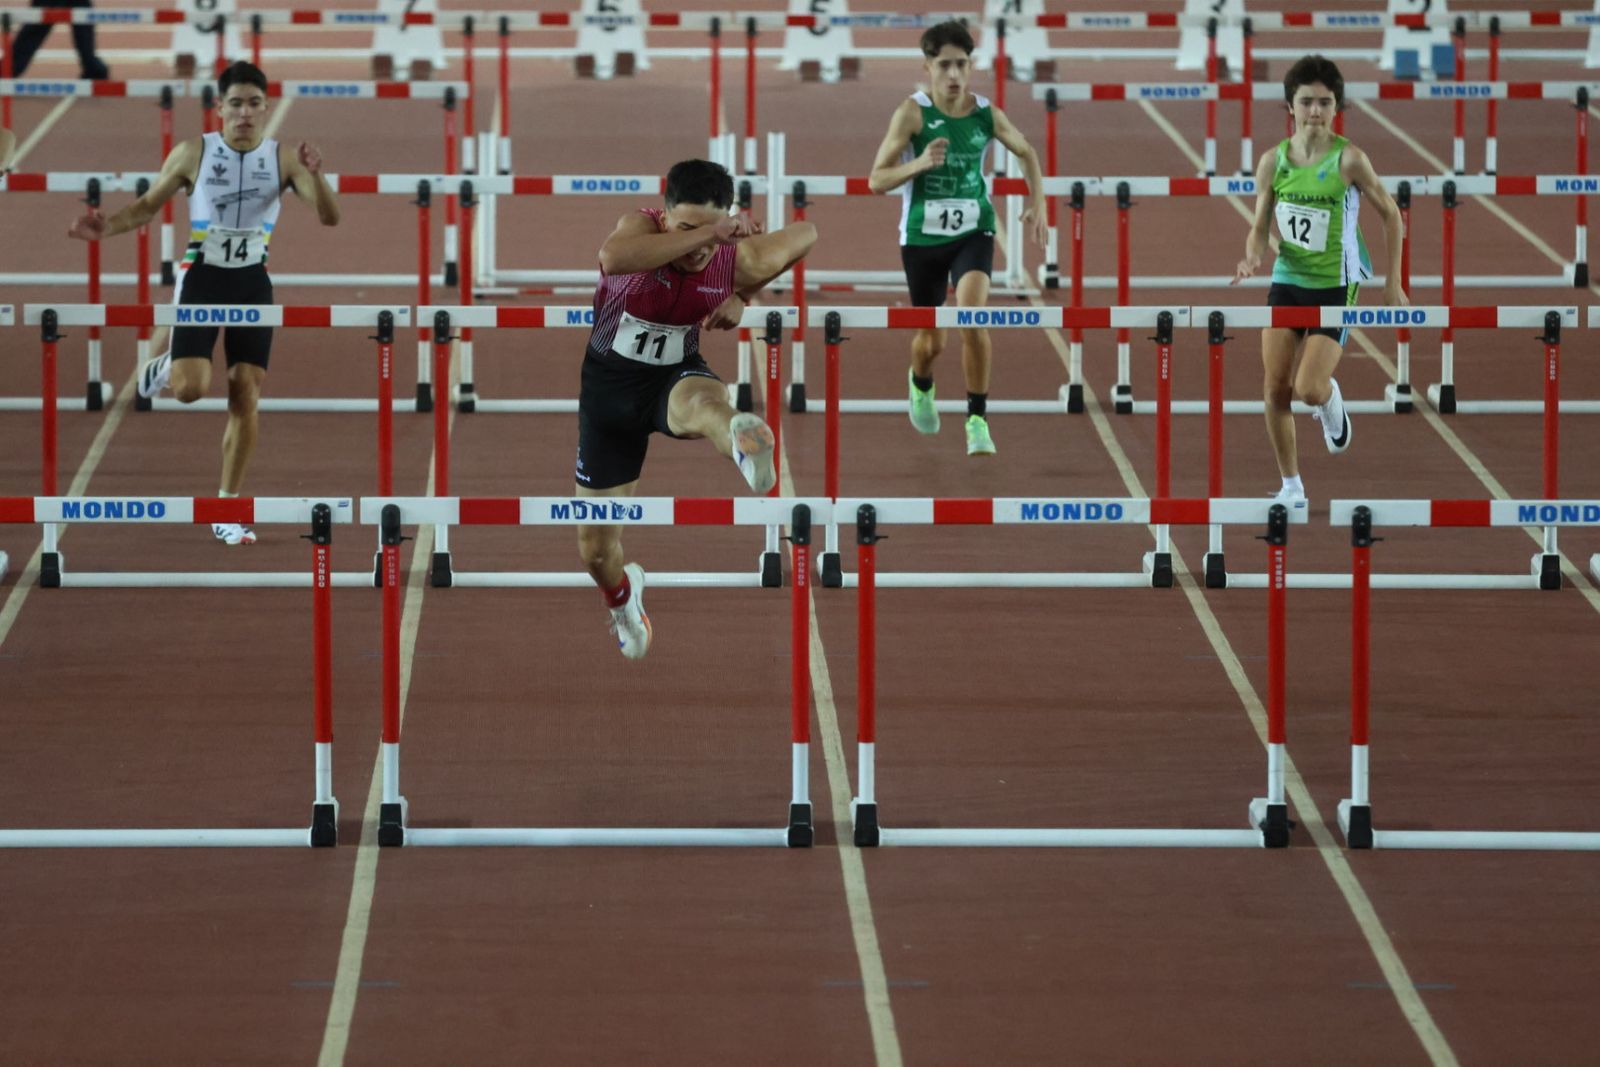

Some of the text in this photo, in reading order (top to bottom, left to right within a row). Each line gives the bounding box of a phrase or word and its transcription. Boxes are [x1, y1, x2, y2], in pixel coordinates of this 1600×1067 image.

[1430, 86, 1491, 96] MONDO
[571, 179, 641, 192] MONDO
[938, 209, 964, 231] 13
[1287, 215, 1312, 244] 12
[221, 237, 249, 262] 14
[177, 309, 261, 323] MONDO
[957, 310, 1041, 325] MONDO
[1342, 310, 1426, 324] MONDO
[634, 331, 668, 359] 11
[62, 502, 165, 519] MONDO
[1020, 503, 1124, 521] MONDO
